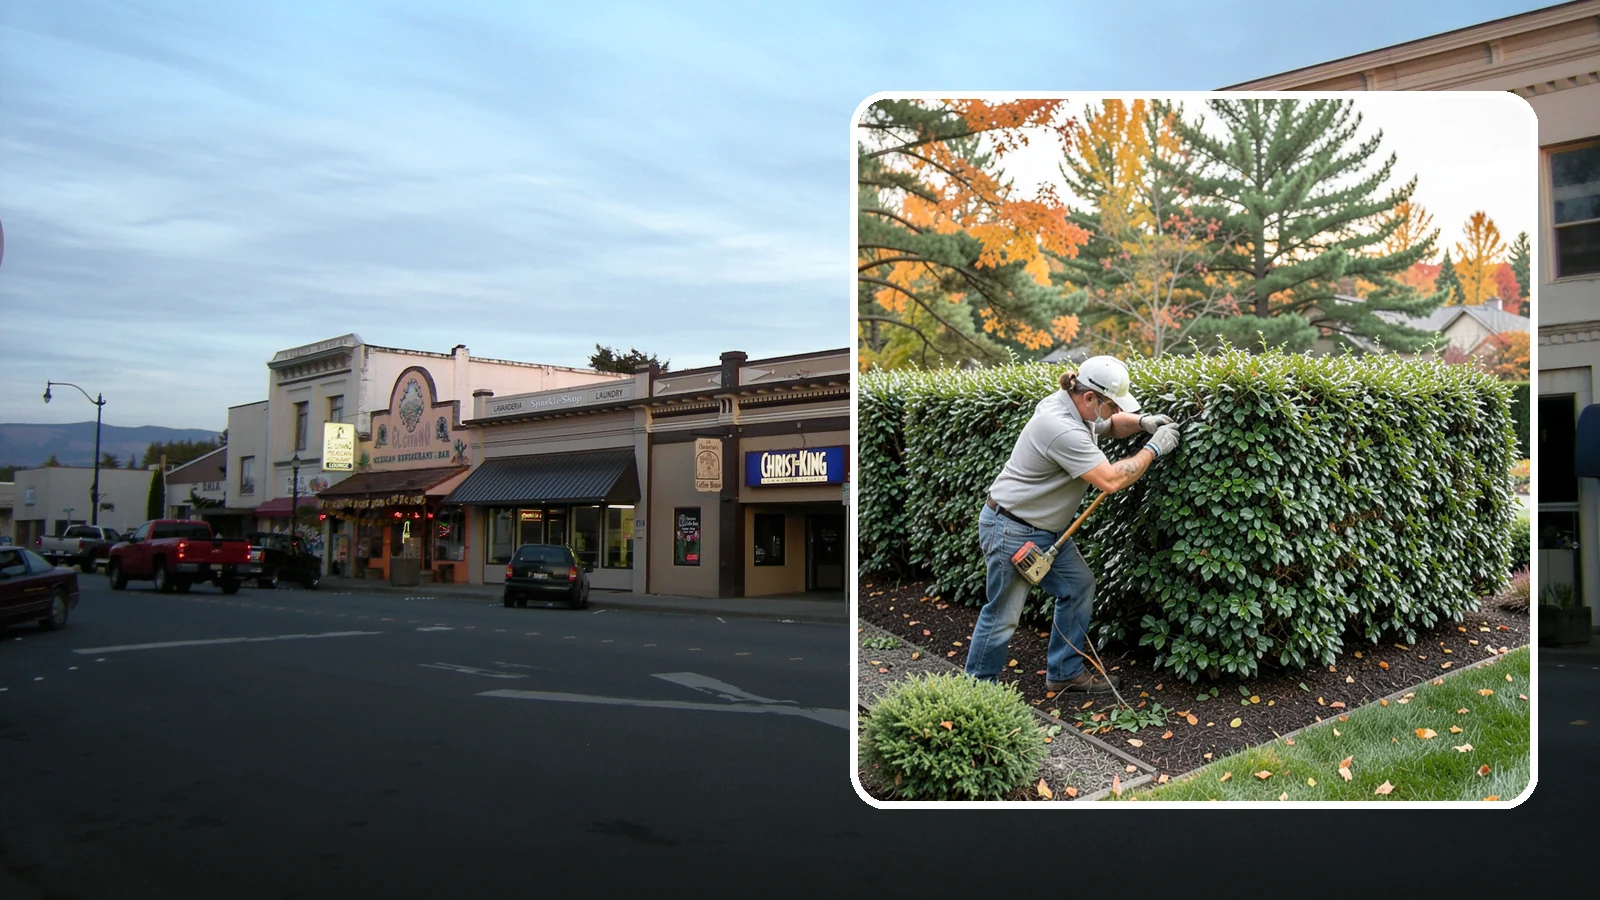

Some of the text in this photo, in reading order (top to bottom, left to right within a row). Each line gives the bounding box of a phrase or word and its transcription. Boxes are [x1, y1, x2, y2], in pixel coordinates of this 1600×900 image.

[595, 389, 623, 400] LAUNDRY
[530, 394, 582, 408] Sparkle Shop
[493, 402, 523, 413] LAVANDERIA
[373, 454, 396, 464] MEXICAN
[397, 451, 434, 463] RESTAURANT
[437, 449, 450, 459] BAR
[760, 450, 828, 478] CHRIST KING
[696, 480, 710, 489] Coffee
